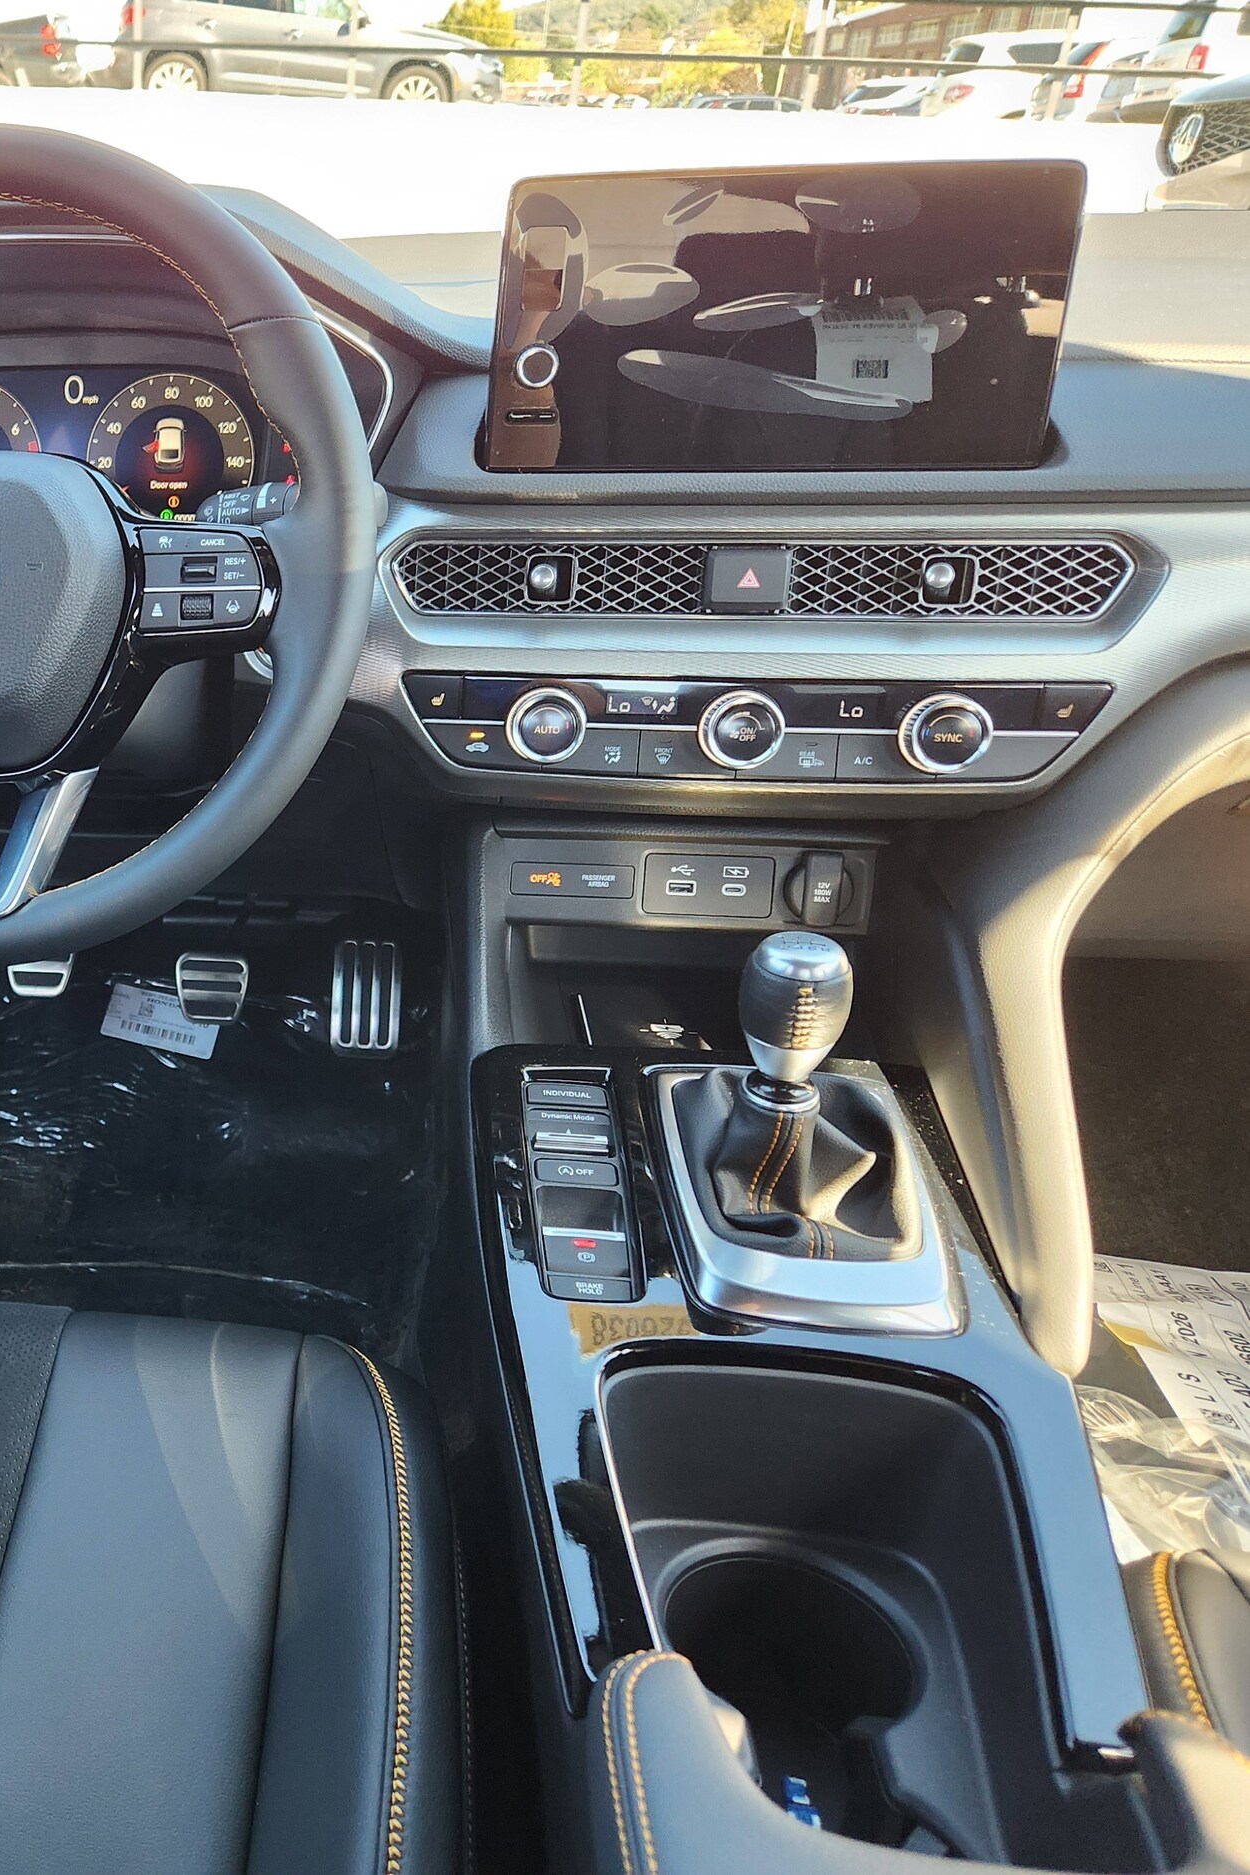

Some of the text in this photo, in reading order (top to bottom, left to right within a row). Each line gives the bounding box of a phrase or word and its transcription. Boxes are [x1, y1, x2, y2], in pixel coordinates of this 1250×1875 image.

[64, 374, 99, 406] 0 mph
[164, 387, 180, 399] 80
[131, 397, 146, 409] 60
[194, 397, 213, 408] 100
[11, 423, 20, 436] 6
[106, 422, 122, 435] 40
[218, 422, 237, 434] 120
[97, 457, 112, 469] 20
[226, 456, 244, 468] 140
[150, 480, 188, 490] Door open
[221, 507, 241, 516] AUTO
[224, 557, 246, 566] RES/+
[534, 725, 560, 735] AUTO
[739, 734, 757, 742] OFF
[933, 733, 963, 744] SYNC
[853, 756, 873, 766] A/C
[530, 874, 548, 883] OFF
[581, 874, 616, 882] PASSENGER
[542, 1089, 592, 1099] INDIVIDUAL
[541, 1112, 573, 1121] Dynamic
[575, 1168, 594, 1176] OFF
[575, 1282, 604, 1290] BRAKE
[578, 1287, 603, 1295] HOLD
[1170, 1310, 1200, 1346] 2026
